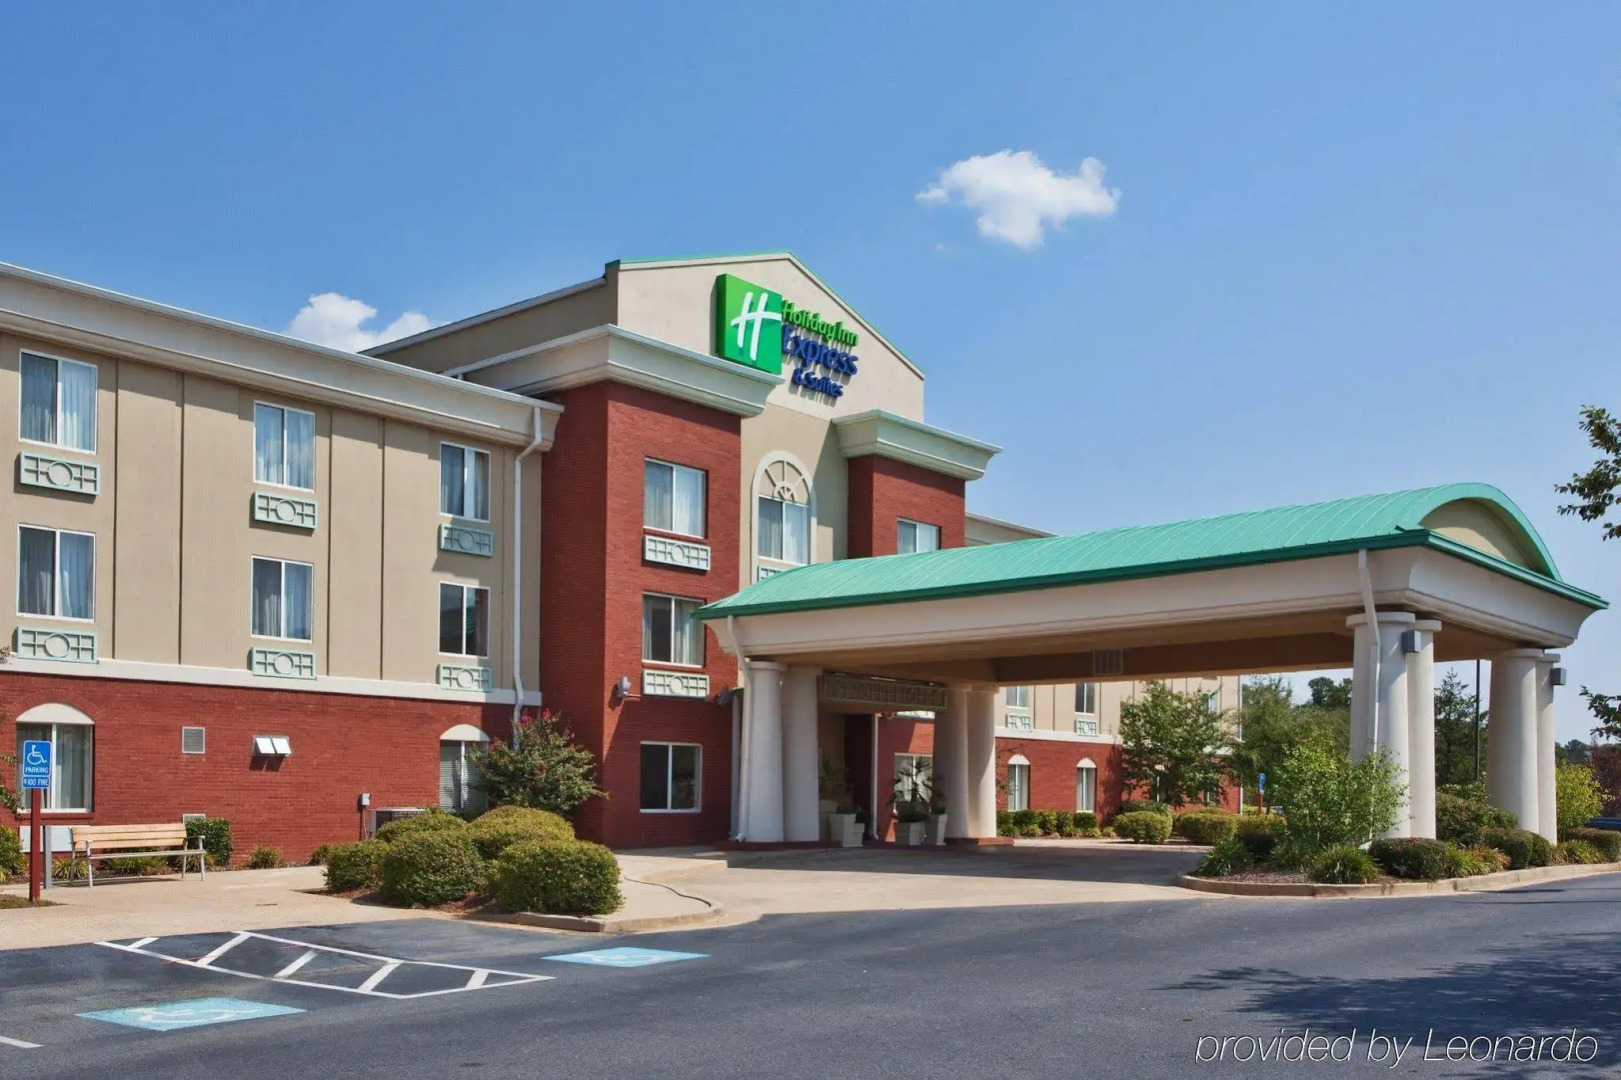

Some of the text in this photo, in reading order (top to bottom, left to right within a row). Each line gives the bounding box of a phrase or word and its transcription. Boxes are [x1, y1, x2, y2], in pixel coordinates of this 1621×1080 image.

[782, 299, 859, 346] Holiday Inn
[782, 324, 858, 375] Express
[791, 367, 844, 398] & Suites
[37, 778, 49, 786] FINE
